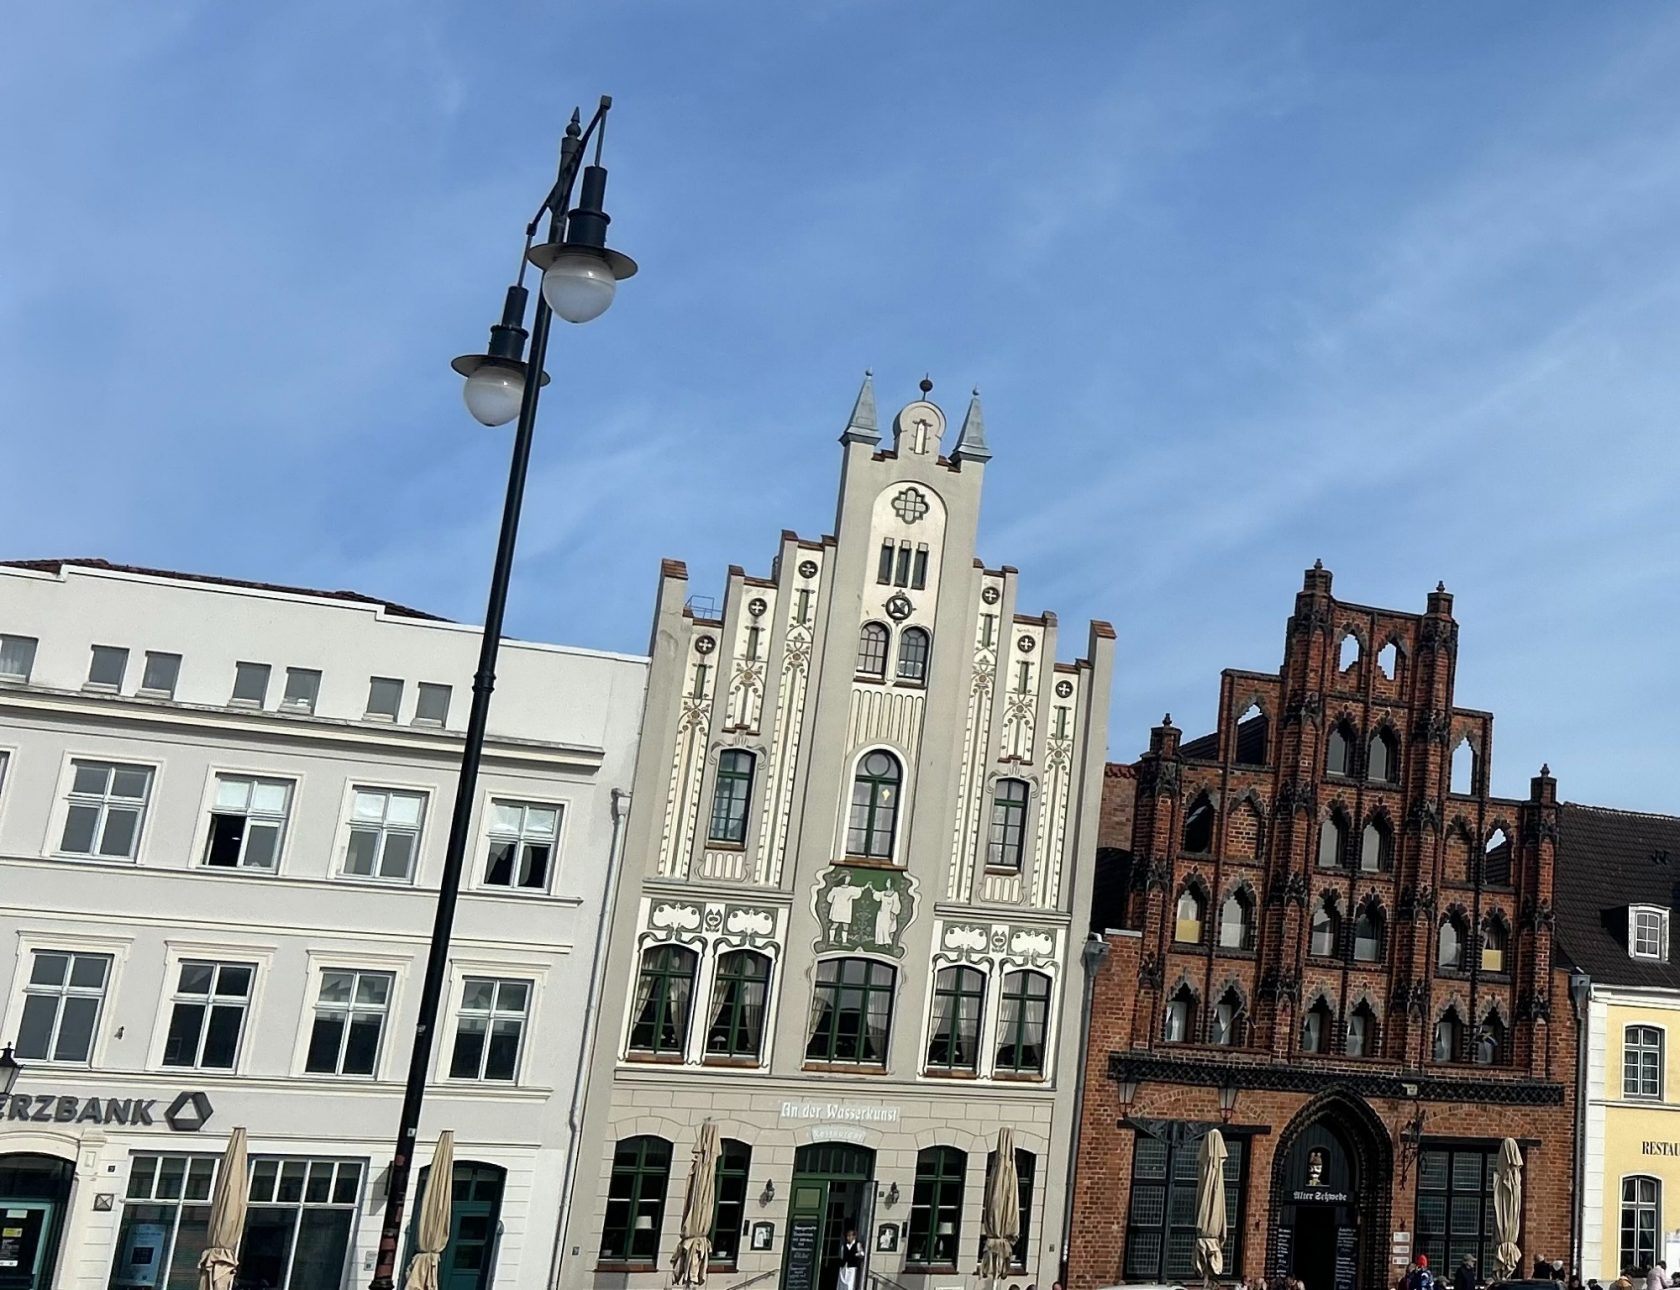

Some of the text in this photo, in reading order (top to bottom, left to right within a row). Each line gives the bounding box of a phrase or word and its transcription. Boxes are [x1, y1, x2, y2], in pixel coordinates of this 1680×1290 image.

[781, 1102, 898, 1122] An der Wasserkunst
[1293, 1191, 1313, 1200] Alter
